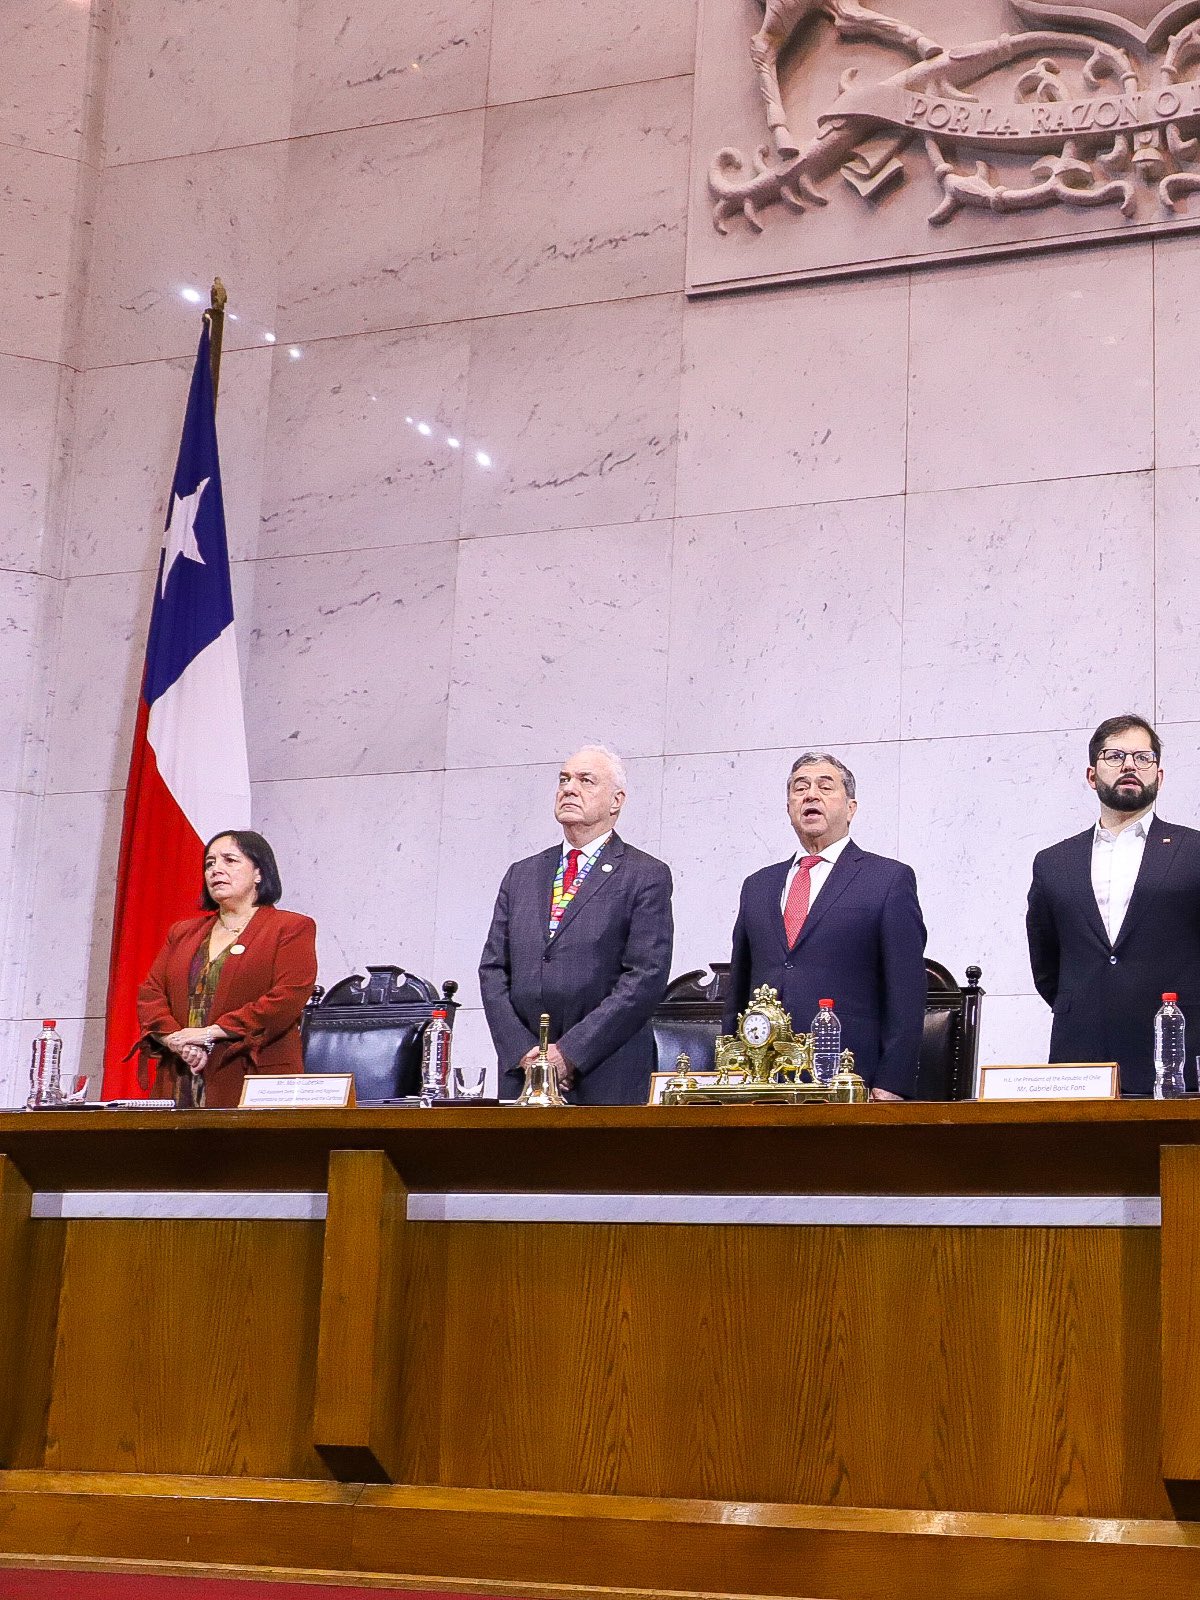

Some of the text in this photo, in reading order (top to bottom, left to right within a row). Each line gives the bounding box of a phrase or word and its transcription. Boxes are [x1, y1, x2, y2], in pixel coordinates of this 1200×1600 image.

[904, 97, 970, 133] POR
[976, 108, 1019, 135] LA
[1030, 96, 1141, 135] RAZON
[1154, 91, 1181, 117] O
